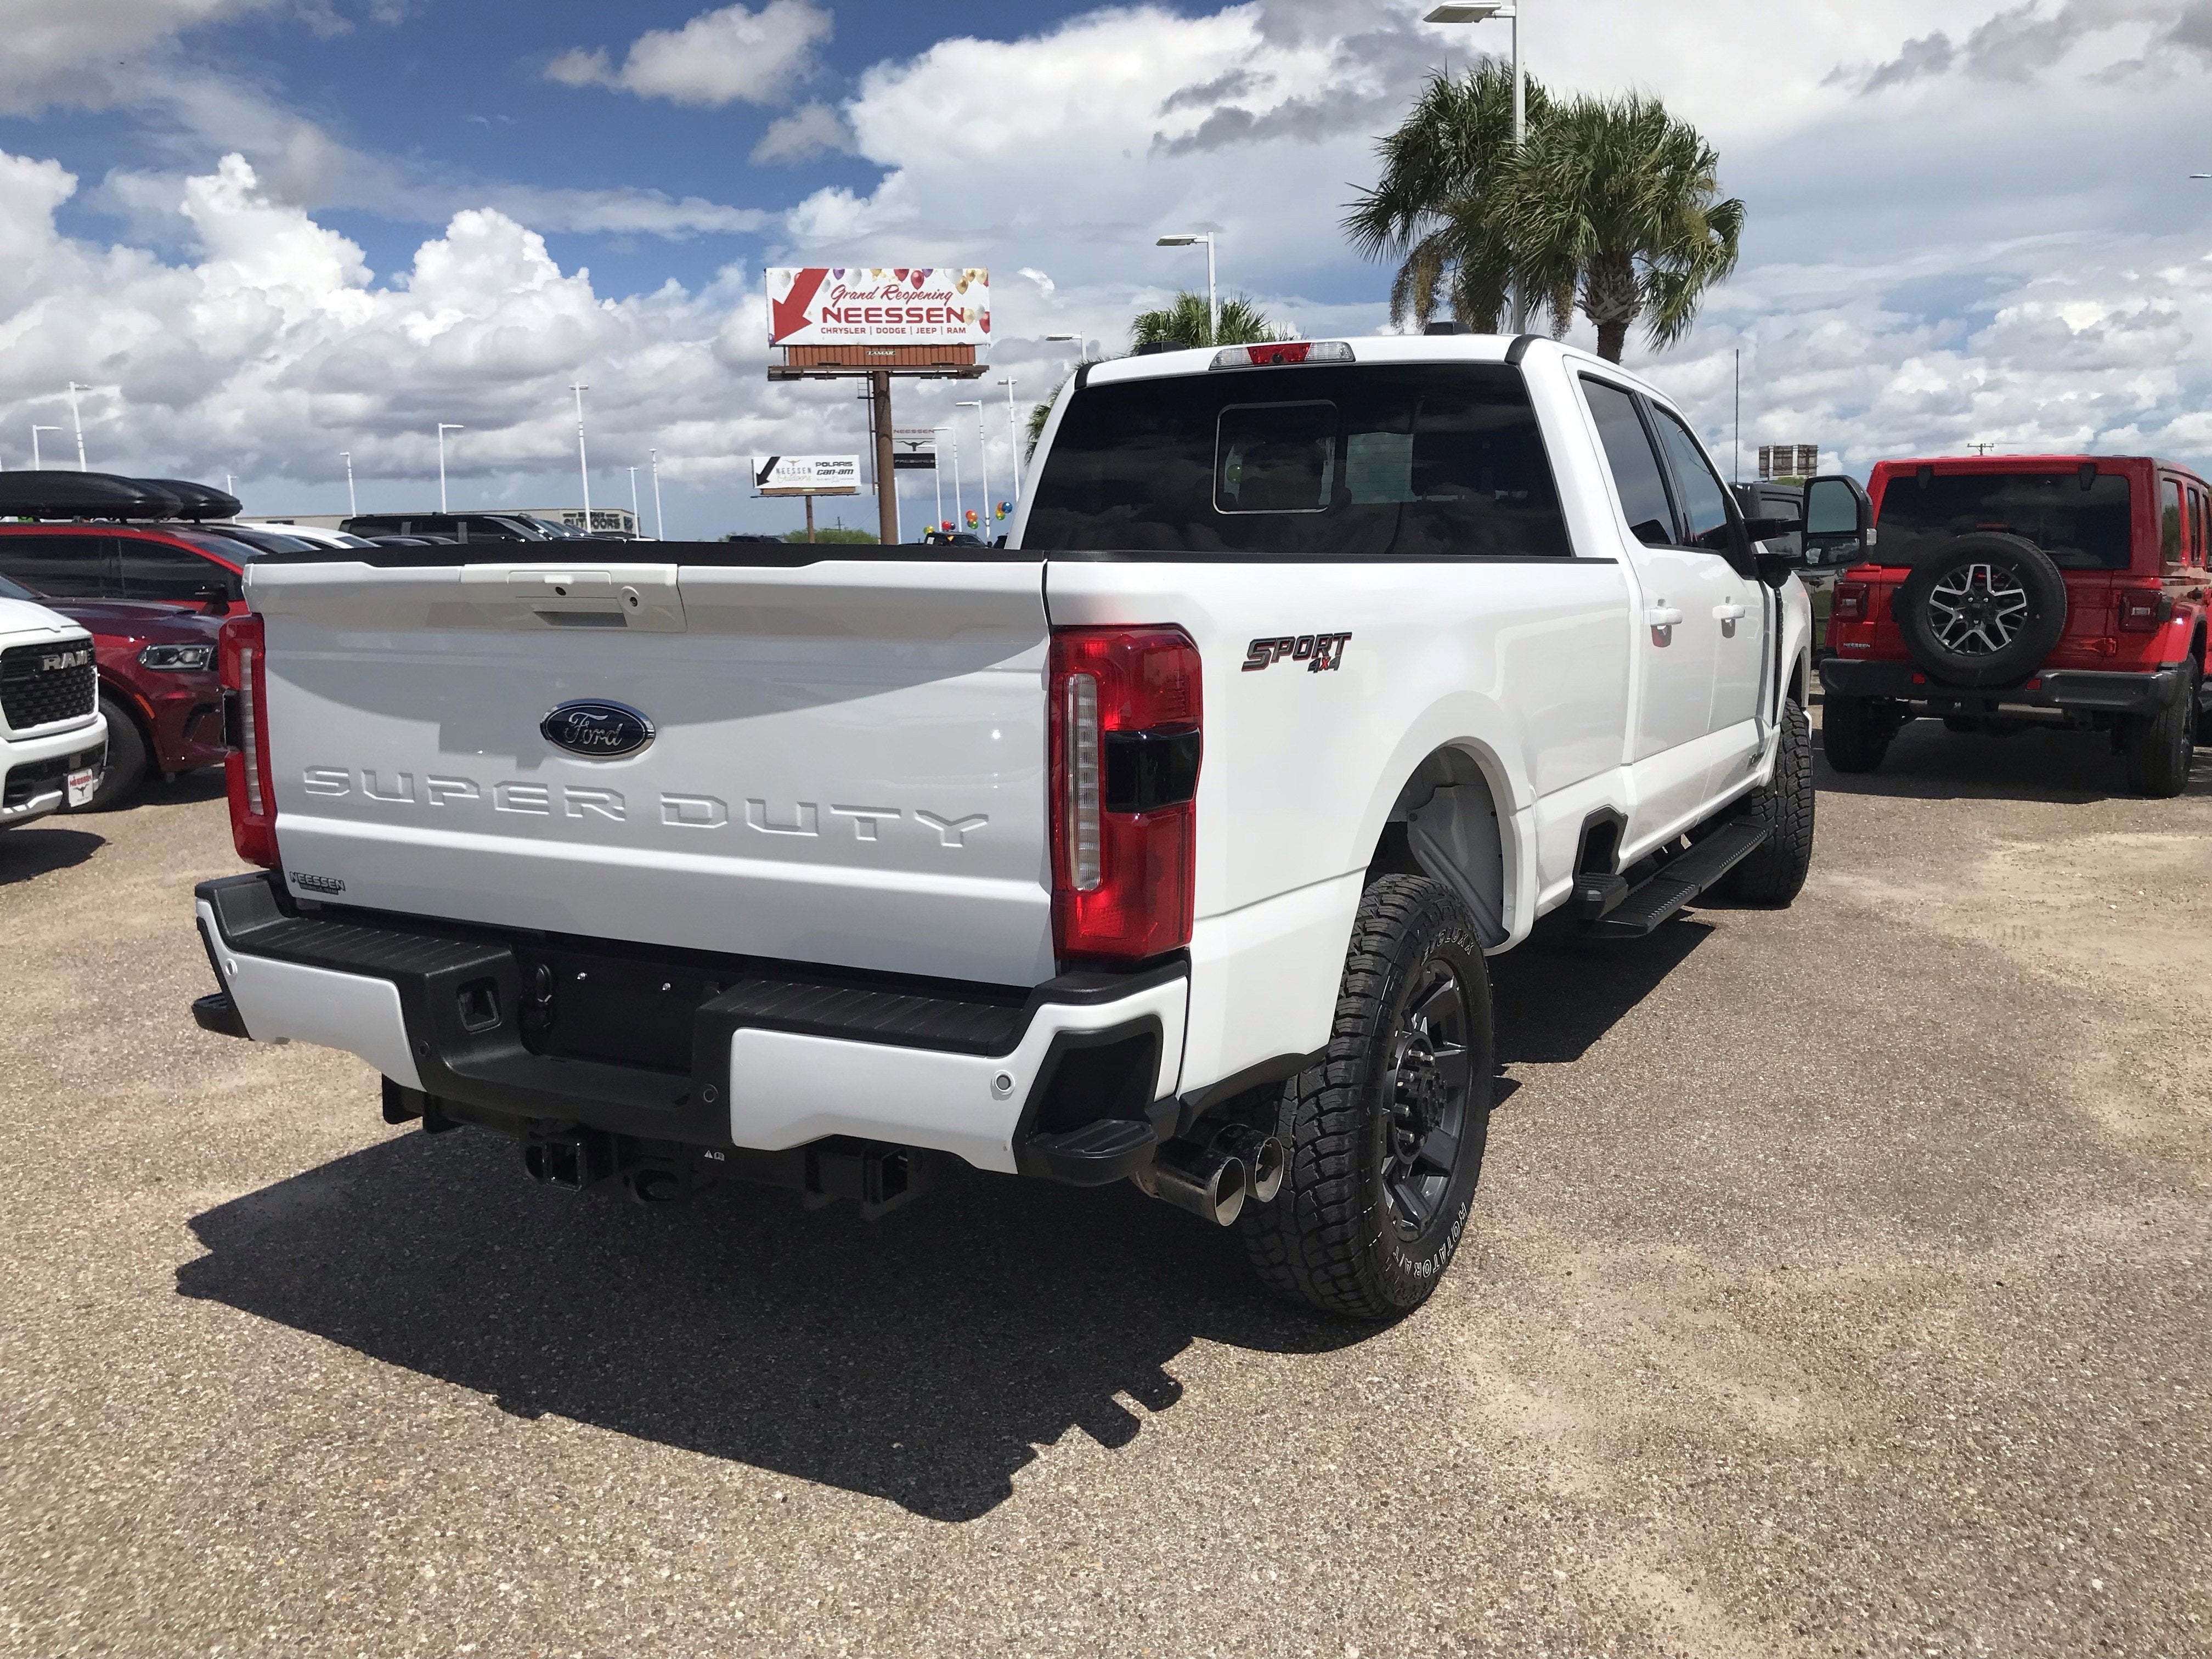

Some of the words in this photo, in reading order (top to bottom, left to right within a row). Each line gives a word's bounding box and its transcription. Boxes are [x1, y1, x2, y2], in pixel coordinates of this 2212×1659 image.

[831, 284, 879, 308] Grand
[880, 284, 953, 307] Reopening
[822, 307, 965, 324] NEESSEN
[42, 650, 88, 670] RAM
[1241, 631, 1353, 672] SPORT
[564, 712, 624, 746] Ford
[303, 765, 626, 822] SUPER
[660, 792, 989, 848] DUTY
[289, 871, 346, 891] NEESSEN
[1413, 1201, 1468, 1279] ROTATOR
